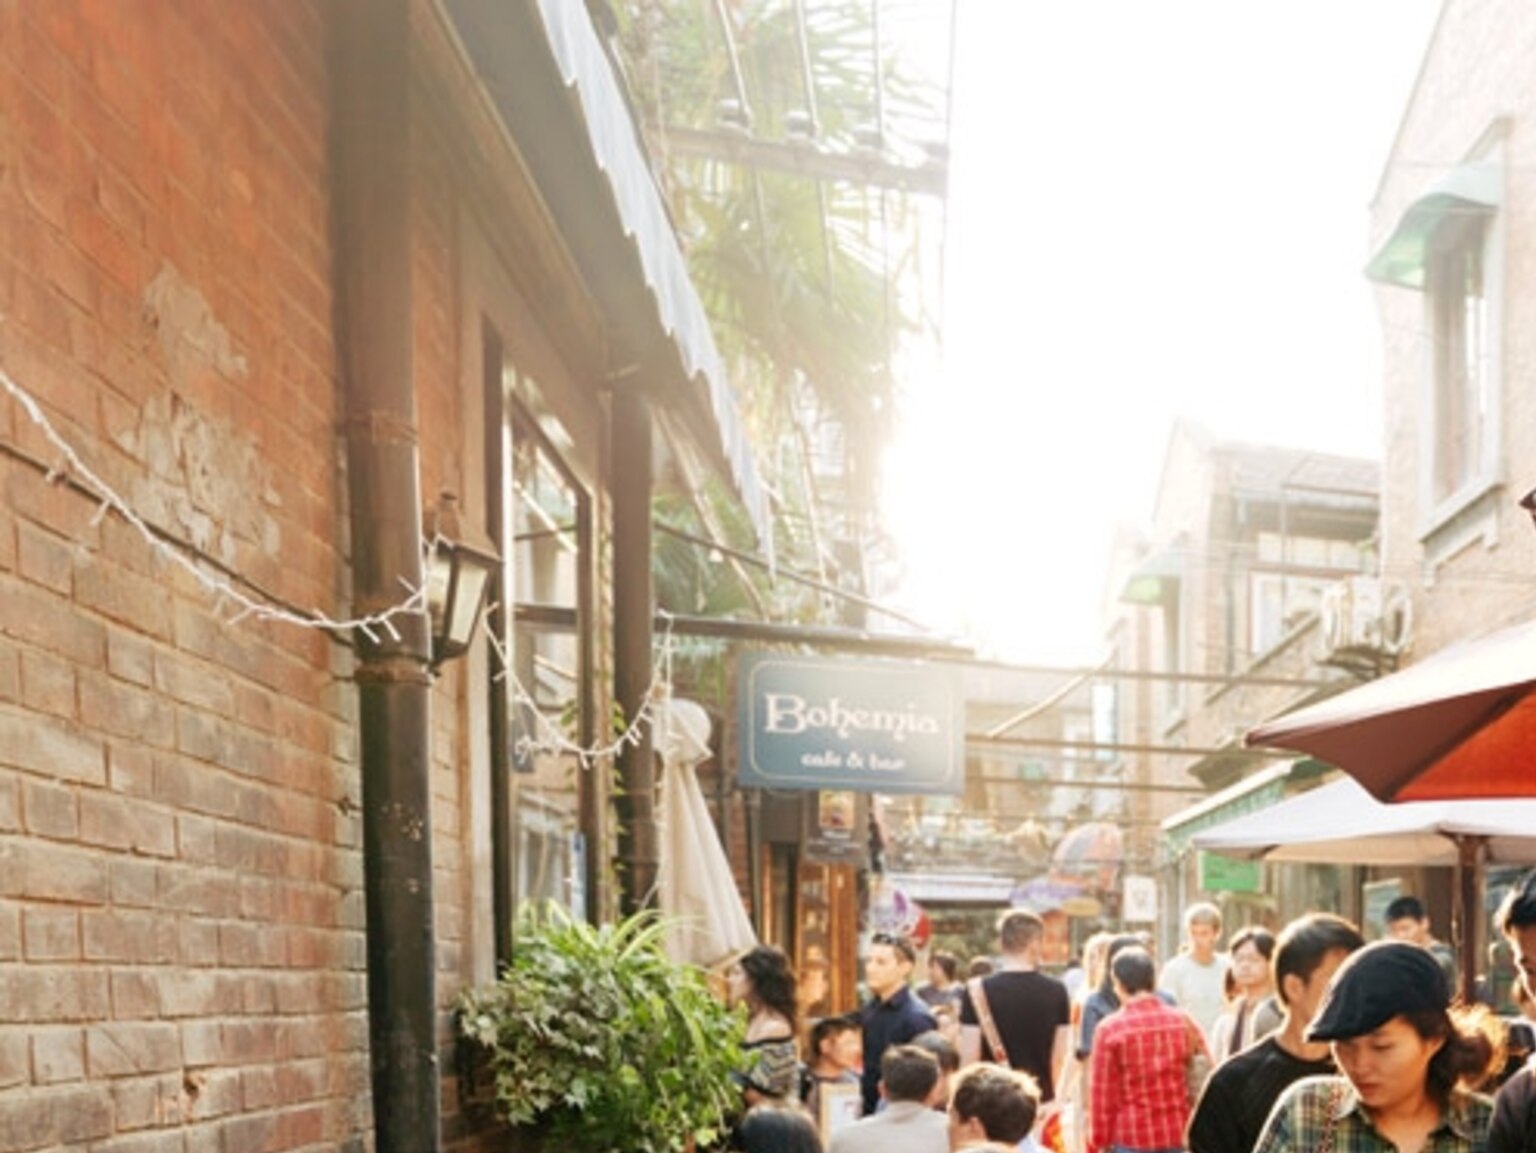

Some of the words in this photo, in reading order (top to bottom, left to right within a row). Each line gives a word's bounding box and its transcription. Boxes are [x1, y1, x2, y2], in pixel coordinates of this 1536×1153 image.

[765, 693, 940, 742] Bohemia
[846, 751, 863, 769] &
[869, 753, 904, 771] bar
